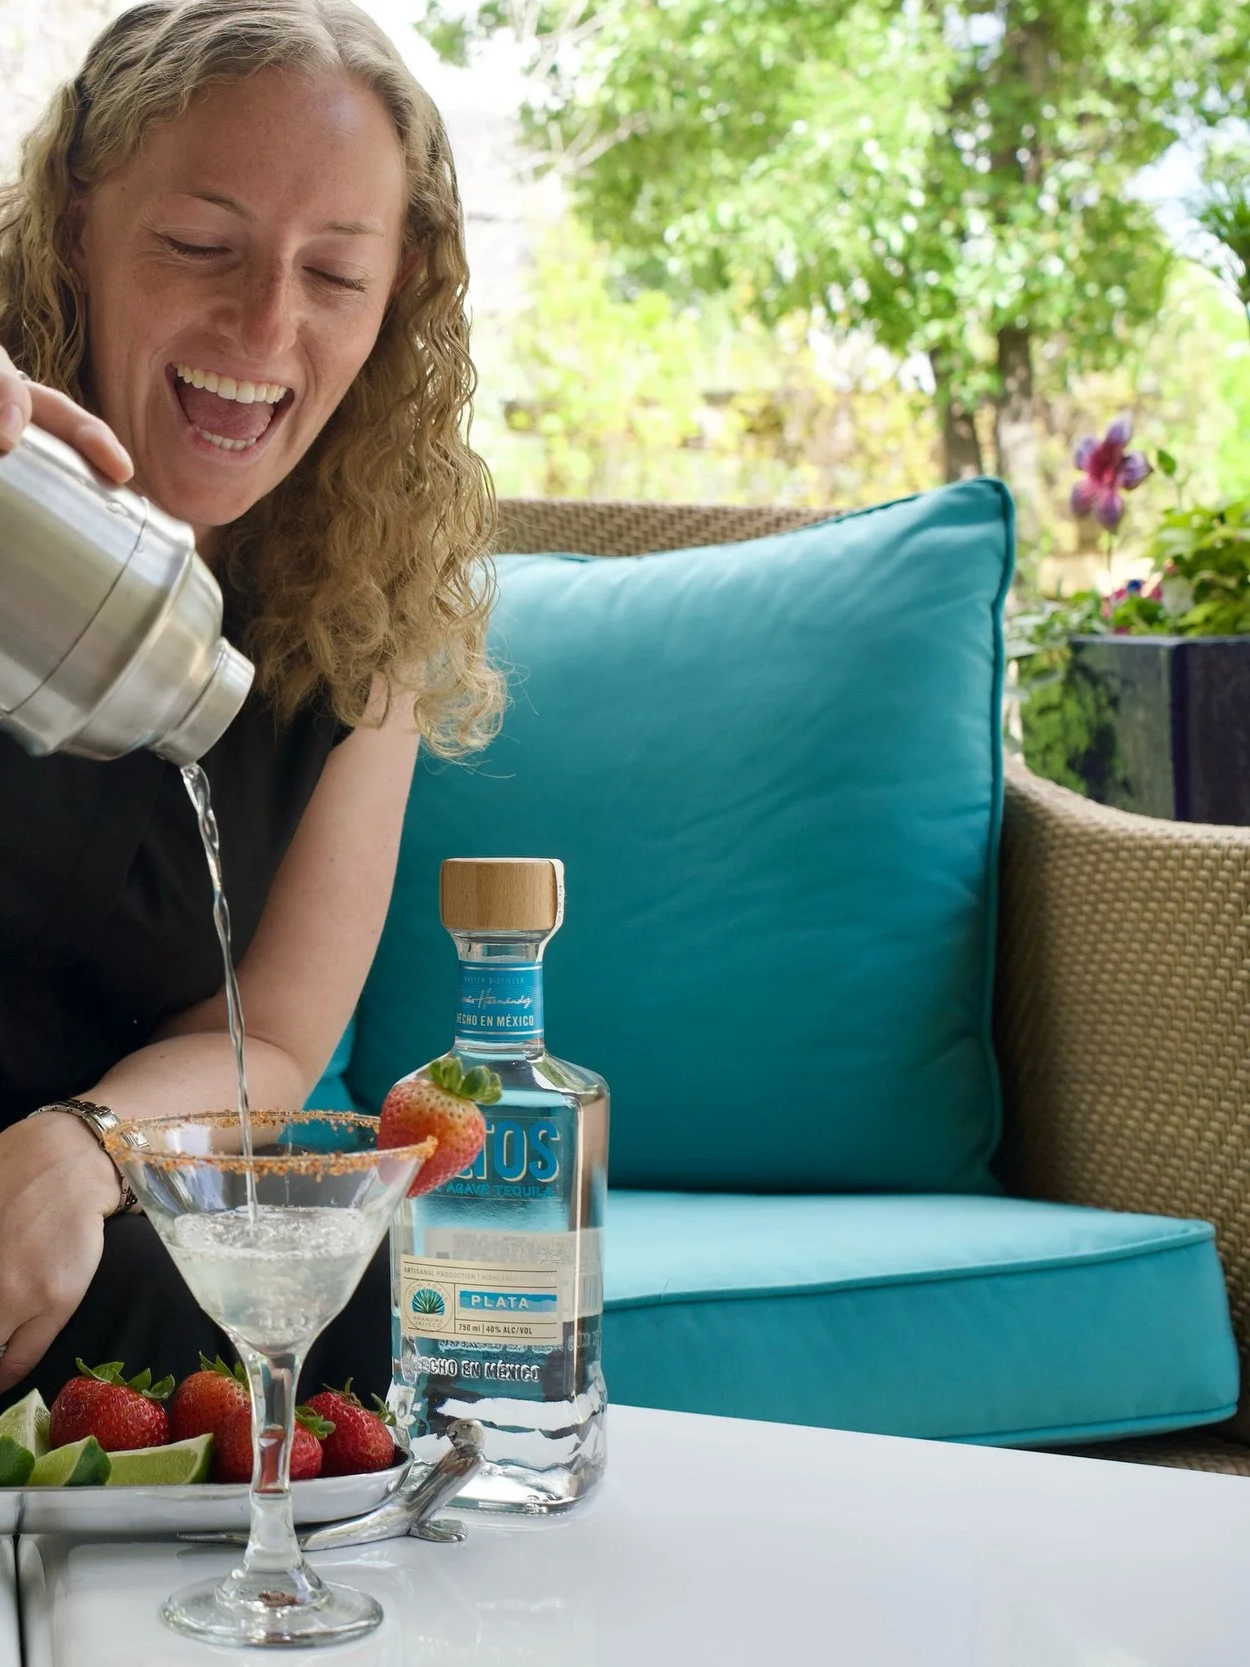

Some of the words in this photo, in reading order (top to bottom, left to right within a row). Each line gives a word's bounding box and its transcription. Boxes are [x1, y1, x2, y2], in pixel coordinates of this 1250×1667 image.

[480, 1015, 493, 1027] EN
[496, 1013, 535, 1027] MÉXICO
[447, 1183, 489, 1194] AGAVE
[494, 1184, 555, 1197] TEQUILA
[470, 1294, 529, 1309] PLATA
[458, 1322, 472, 1332] 750
[485, 1325, 502, 1334] 40%
[502, 1326, 533, 1335] ALC/VOL
[461, 1360, 482, 1379] EN
[484, 1360, 540, 1382] MÉXICO
